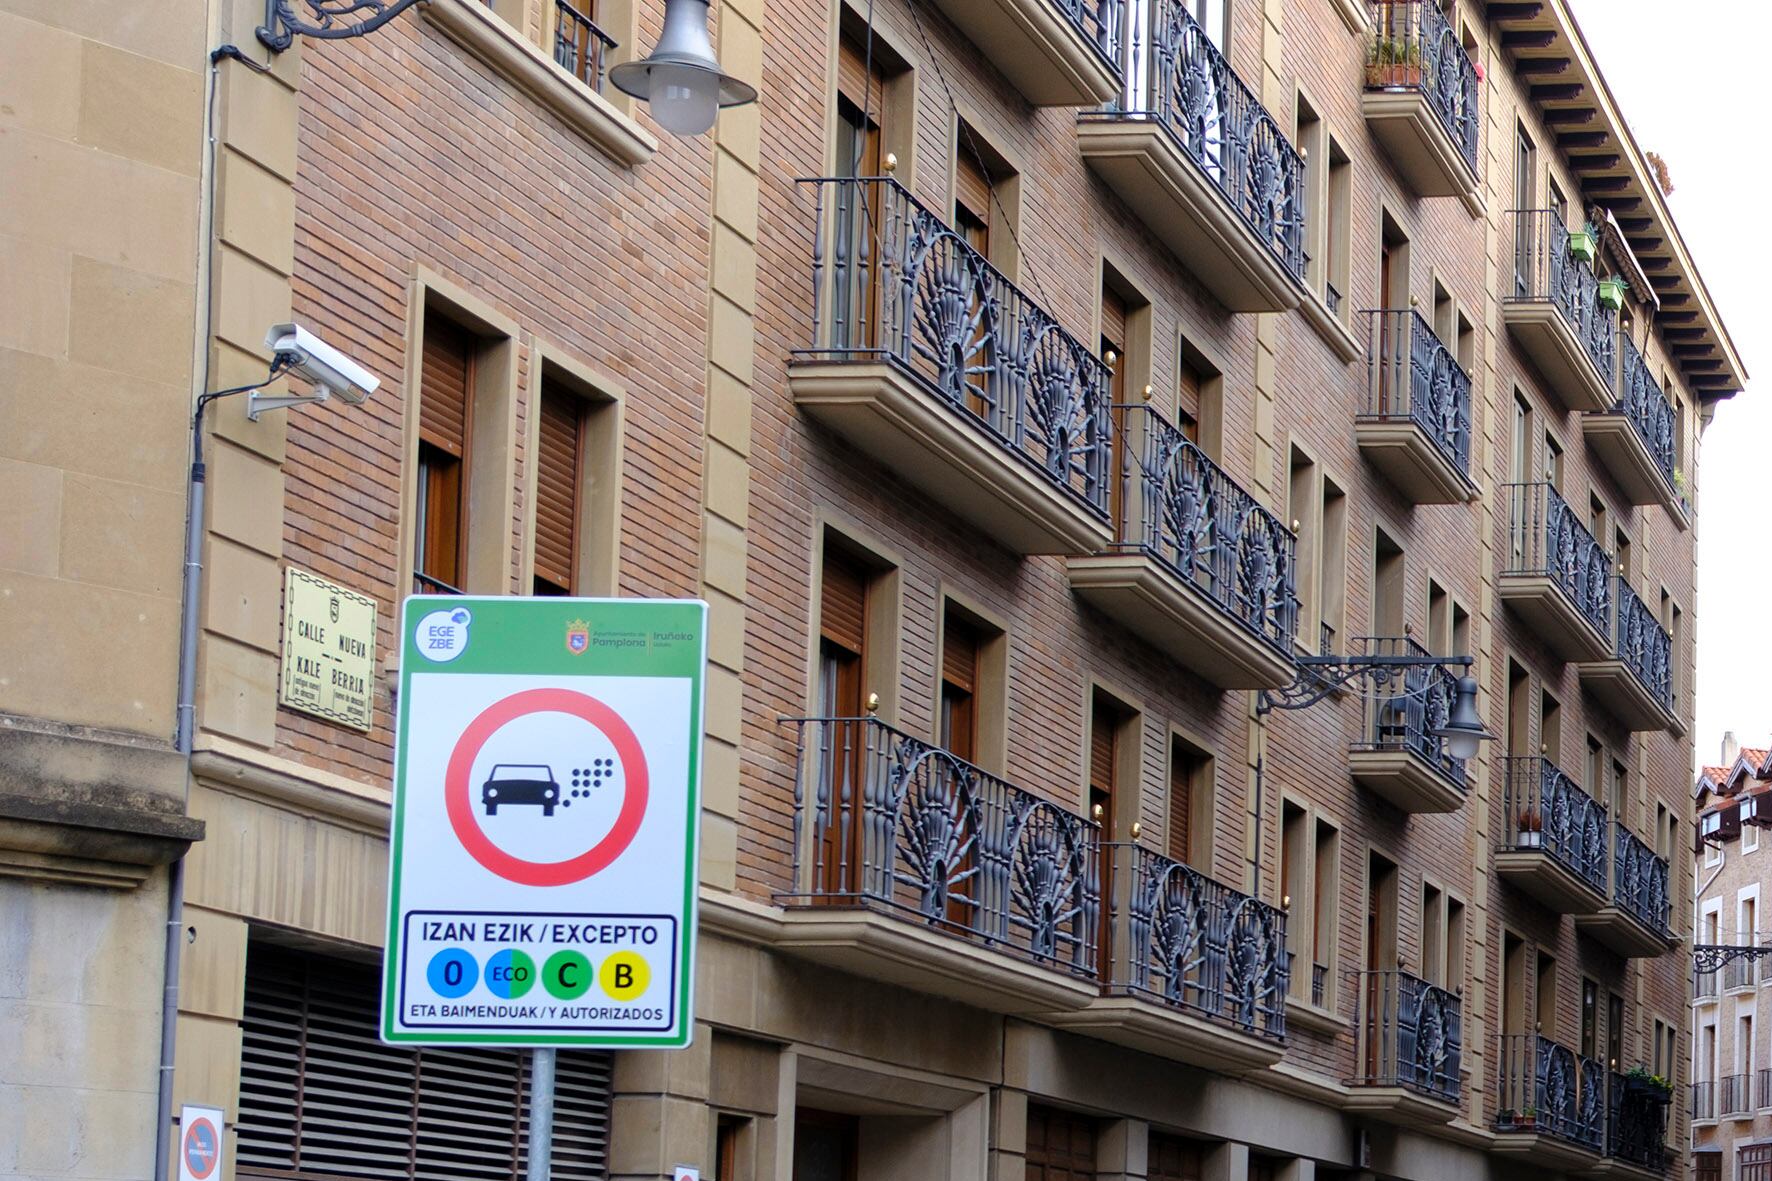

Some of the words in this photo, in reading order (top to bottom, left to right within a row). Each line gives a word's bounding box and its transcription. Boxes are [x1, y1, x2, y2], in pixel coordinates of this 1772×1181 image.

[298, 620, 325, 645] CALLE
[338, 634, 366, 659] NUEVA
[428, 626, 454, 637] EGE
[653, 631, 694, 641] Iruñeko
[428, 638, 454, 650] ZBE
[592, 638, 646, 649] Pamplona
[296, 656, 321, 679] KALE
[331, 668, 364, 695] BERRIA
[423, 922, 475, 942] IZAN
[484, 923, 534, 943] EZIK
[552, 924, 658, 945] EXCEPTO
[493, 966, 528, 982] ECO
[557, 962, 578, 988] C
[614, 963, 634, 988] B
[411, 1004, 436, 1017] ETA
[441, 1005, 537, 1019] BAIMENDUAK
[548, 1007, 557, 1019] Y
[560, 1006, 663, 1021] AUTORIZADOS
